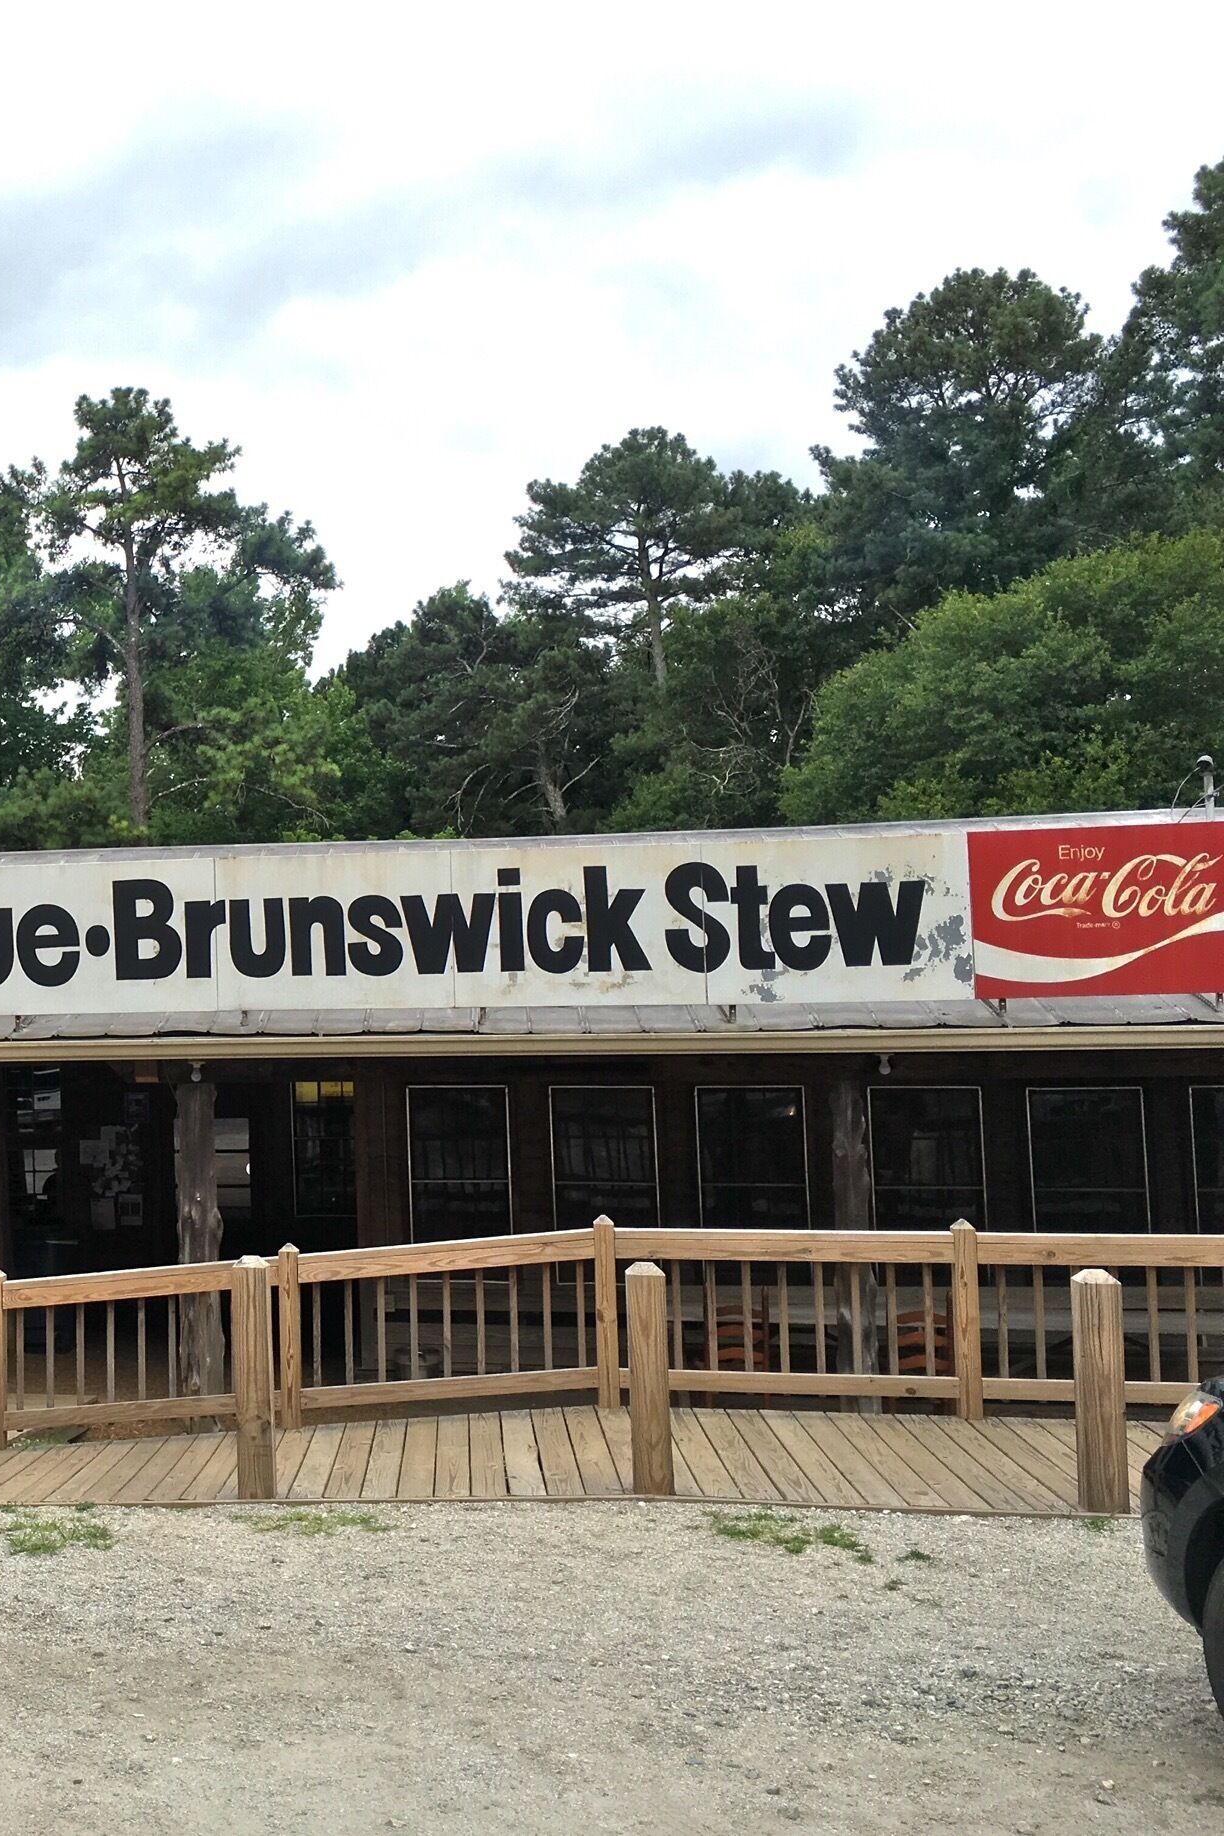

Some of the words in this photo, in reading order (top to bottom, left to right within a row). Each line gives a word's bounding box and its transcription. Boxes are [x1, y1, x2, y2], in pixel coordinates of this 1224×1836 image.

[991, 852, 1223, 922] Coca-Cola
[1058, 844, 1105, 862] Enjoy
[112, 865, 653, 981] Brunswick
[664, 861, 926, 974] Stew
